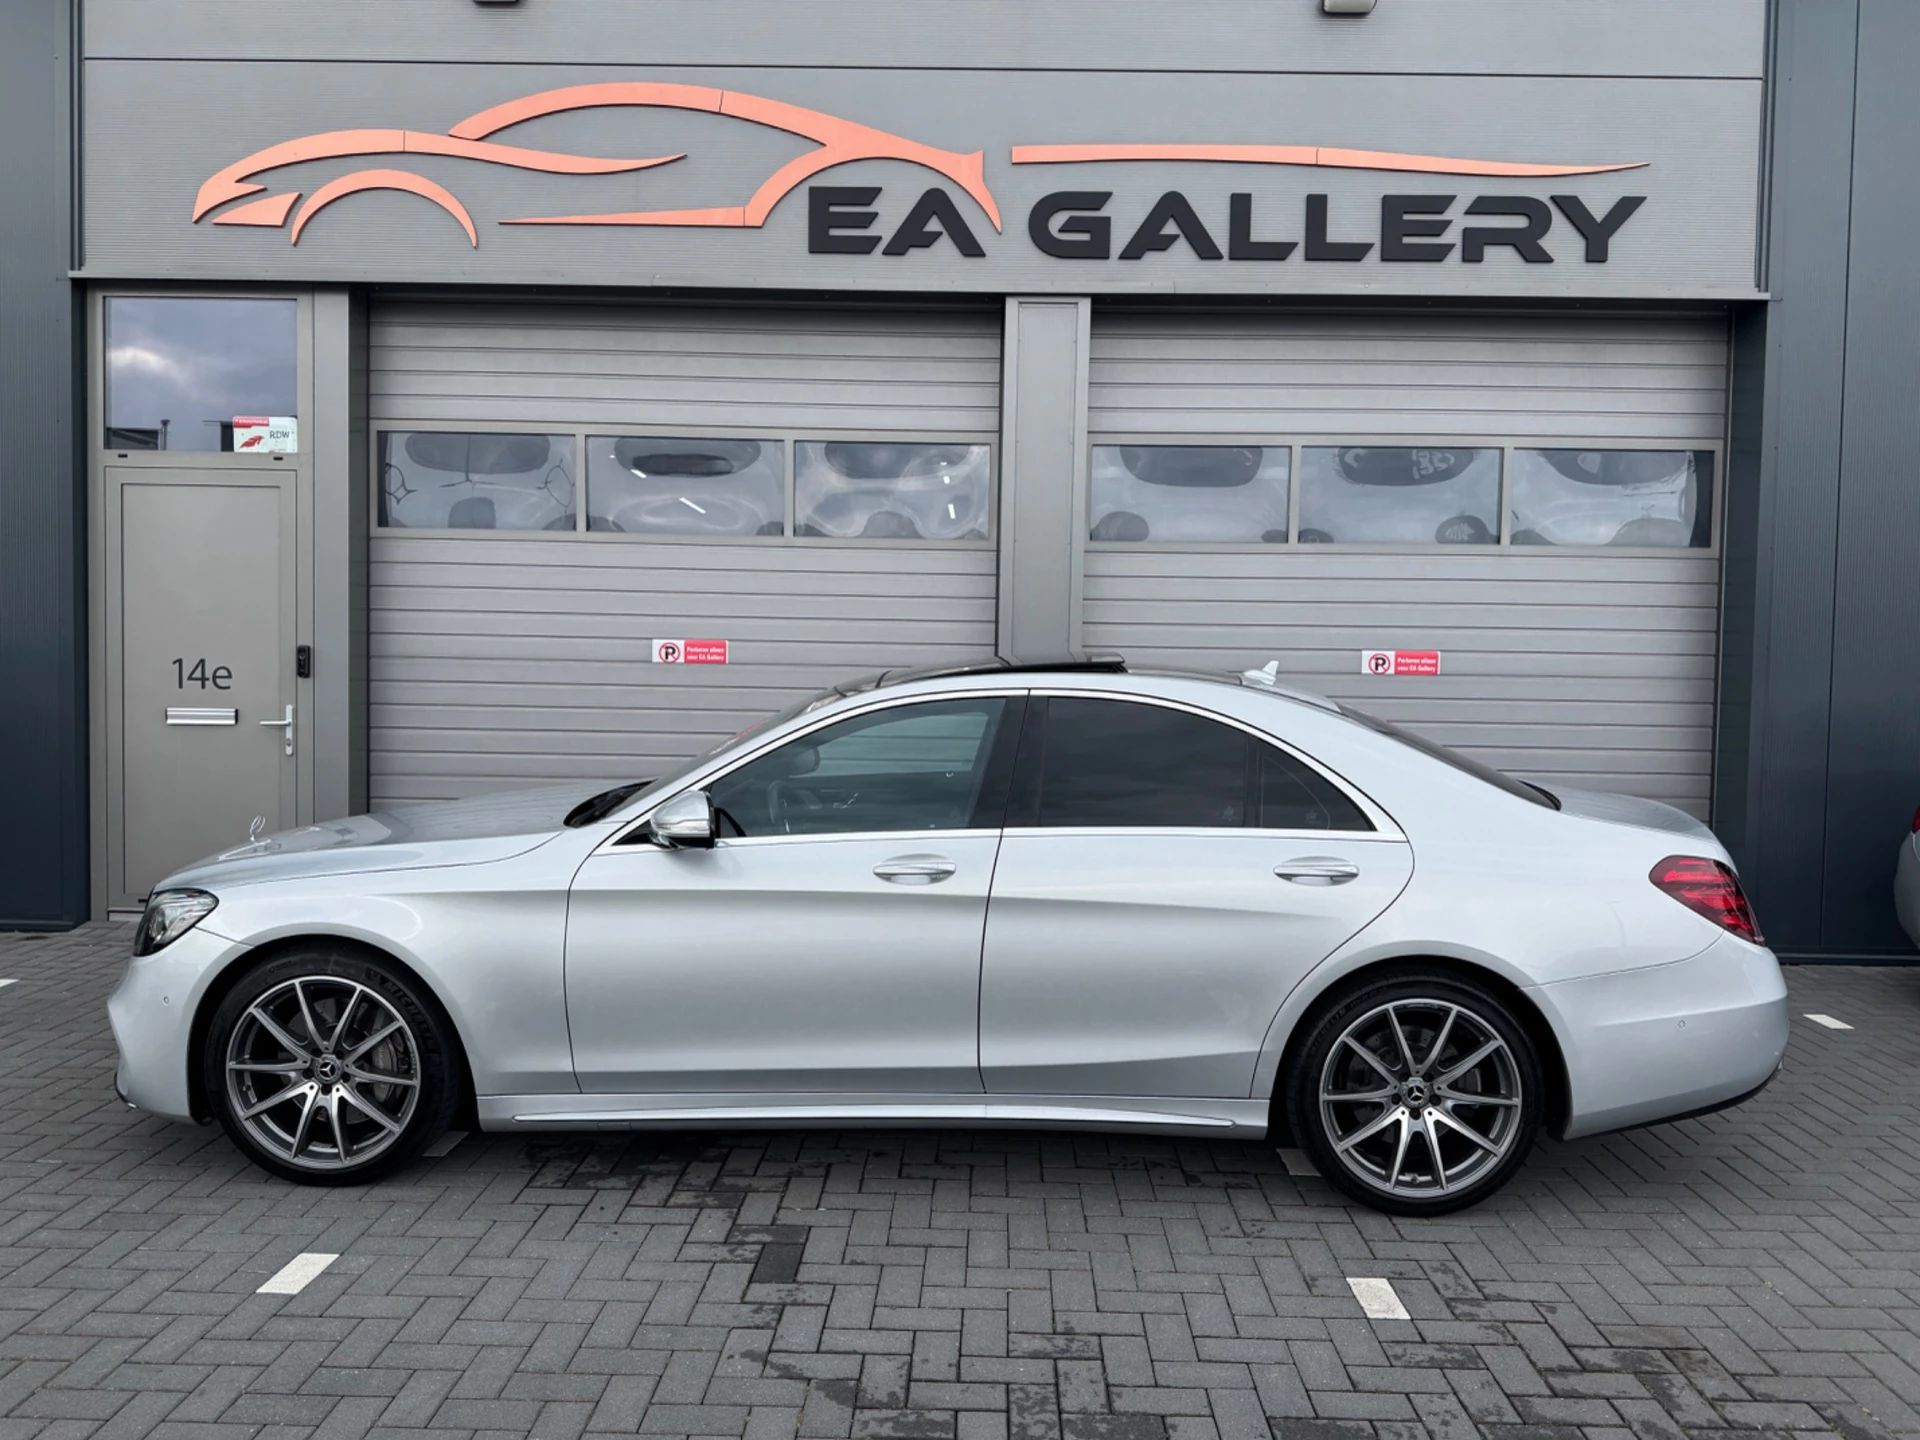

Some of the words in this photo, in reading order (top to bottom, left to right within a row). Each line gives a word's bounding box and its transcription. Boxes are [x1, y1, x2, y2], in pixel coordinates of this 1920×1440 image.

[808, 186, 986, 257] EA
[1027, 190, 1648, 263] GALLERY
[269, 430, 290, 439] RDW
[172, 657, 233, 690] 14e
